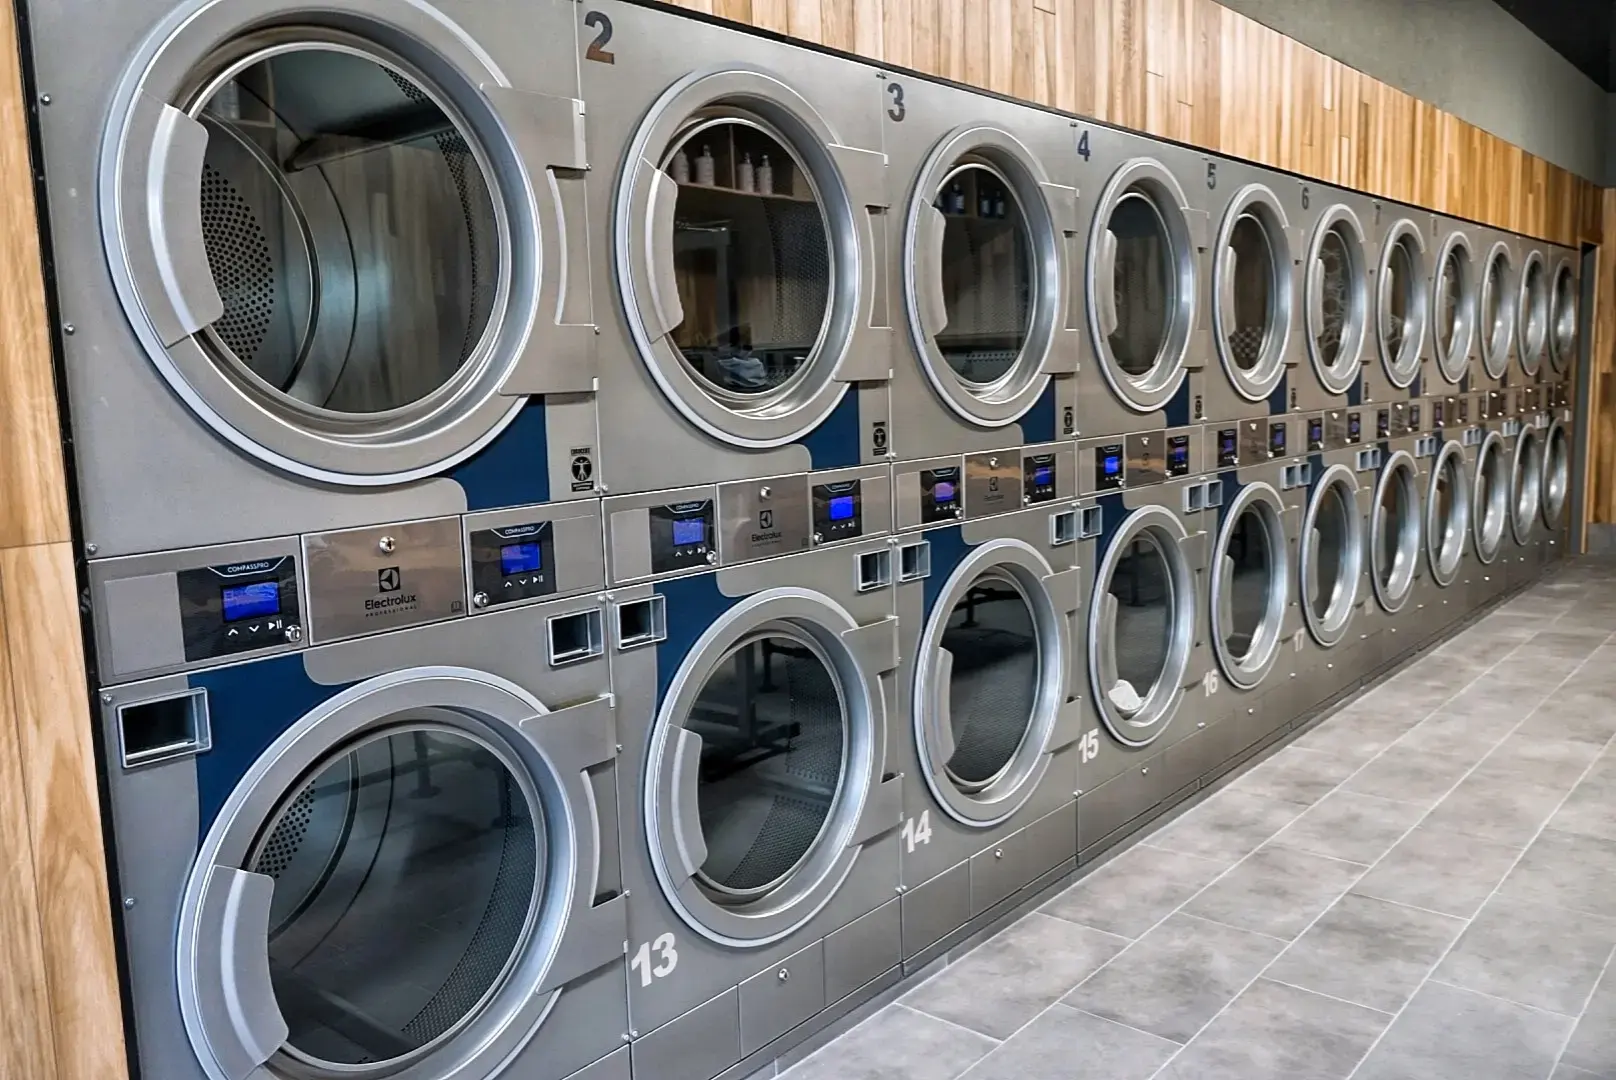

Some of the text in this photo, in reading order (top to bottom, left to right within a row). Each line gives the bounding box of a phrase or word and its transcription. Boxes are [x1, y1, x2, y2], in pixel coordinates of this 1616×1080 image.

[584, 10, 615, 65] 2
[887, 82, 905, 122] 3
[1077, 130, 1091, 162] 4
[1207, 162, 1217, 190] 5
[1302, 187, 1309, 210] 6
[227, 561, 270, 573] COMPASSPRO
[364, 594, 417, 610] Electrolux
[365, 605, 417, 617] PROFESSIONAL
[1202, 668, 1218, 697] 16
[1078, 728, 1099, 763] 15
[901, 809, 932, 853] 14
[631, 932, 678, 988] 13
